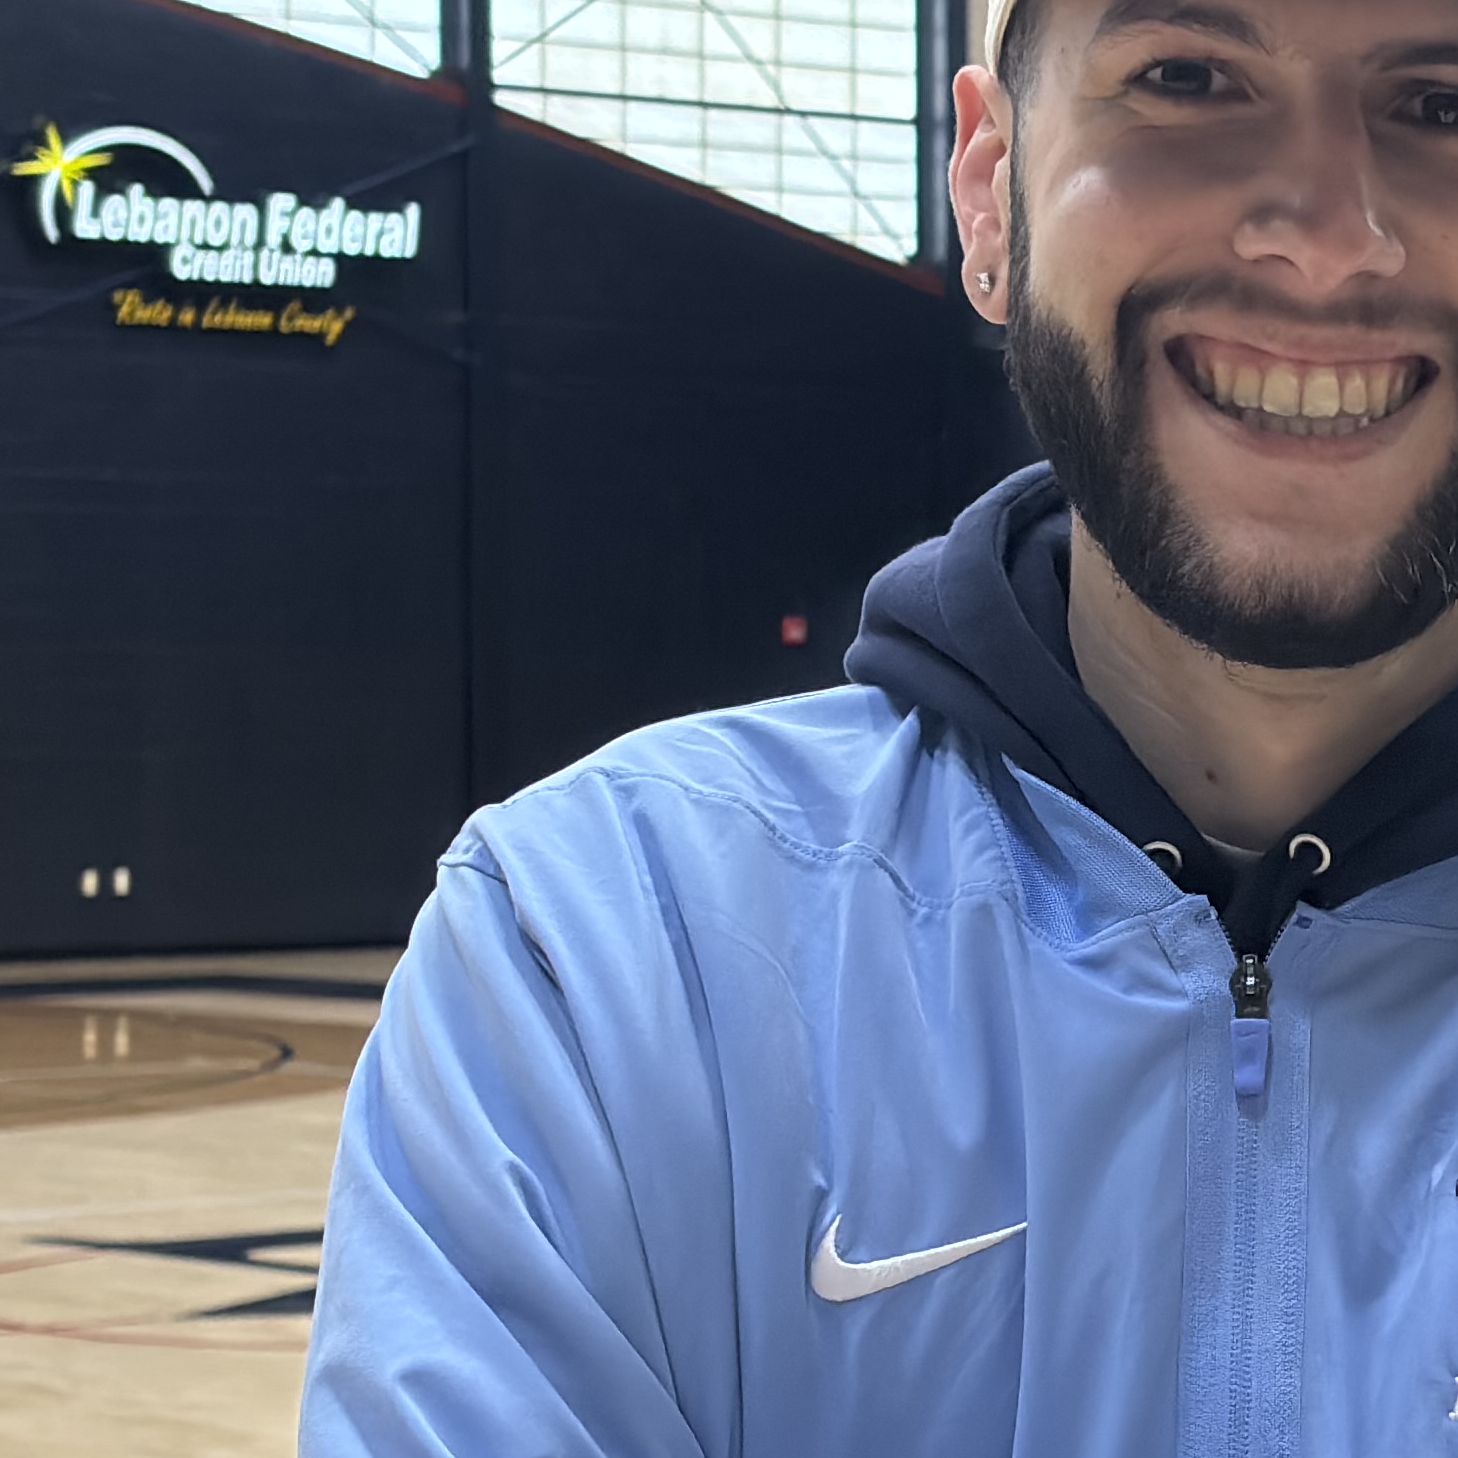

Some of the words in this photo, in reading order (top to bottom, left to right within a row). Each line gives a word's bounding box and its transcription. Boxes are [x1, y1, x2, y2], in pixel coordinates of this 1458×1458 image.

[74, 179, 258, 247] Lebanon
[266, 192, 421, 260] Federal
[171, 244, 254, 284] Credit
[259, 247, 336, 289] Union
